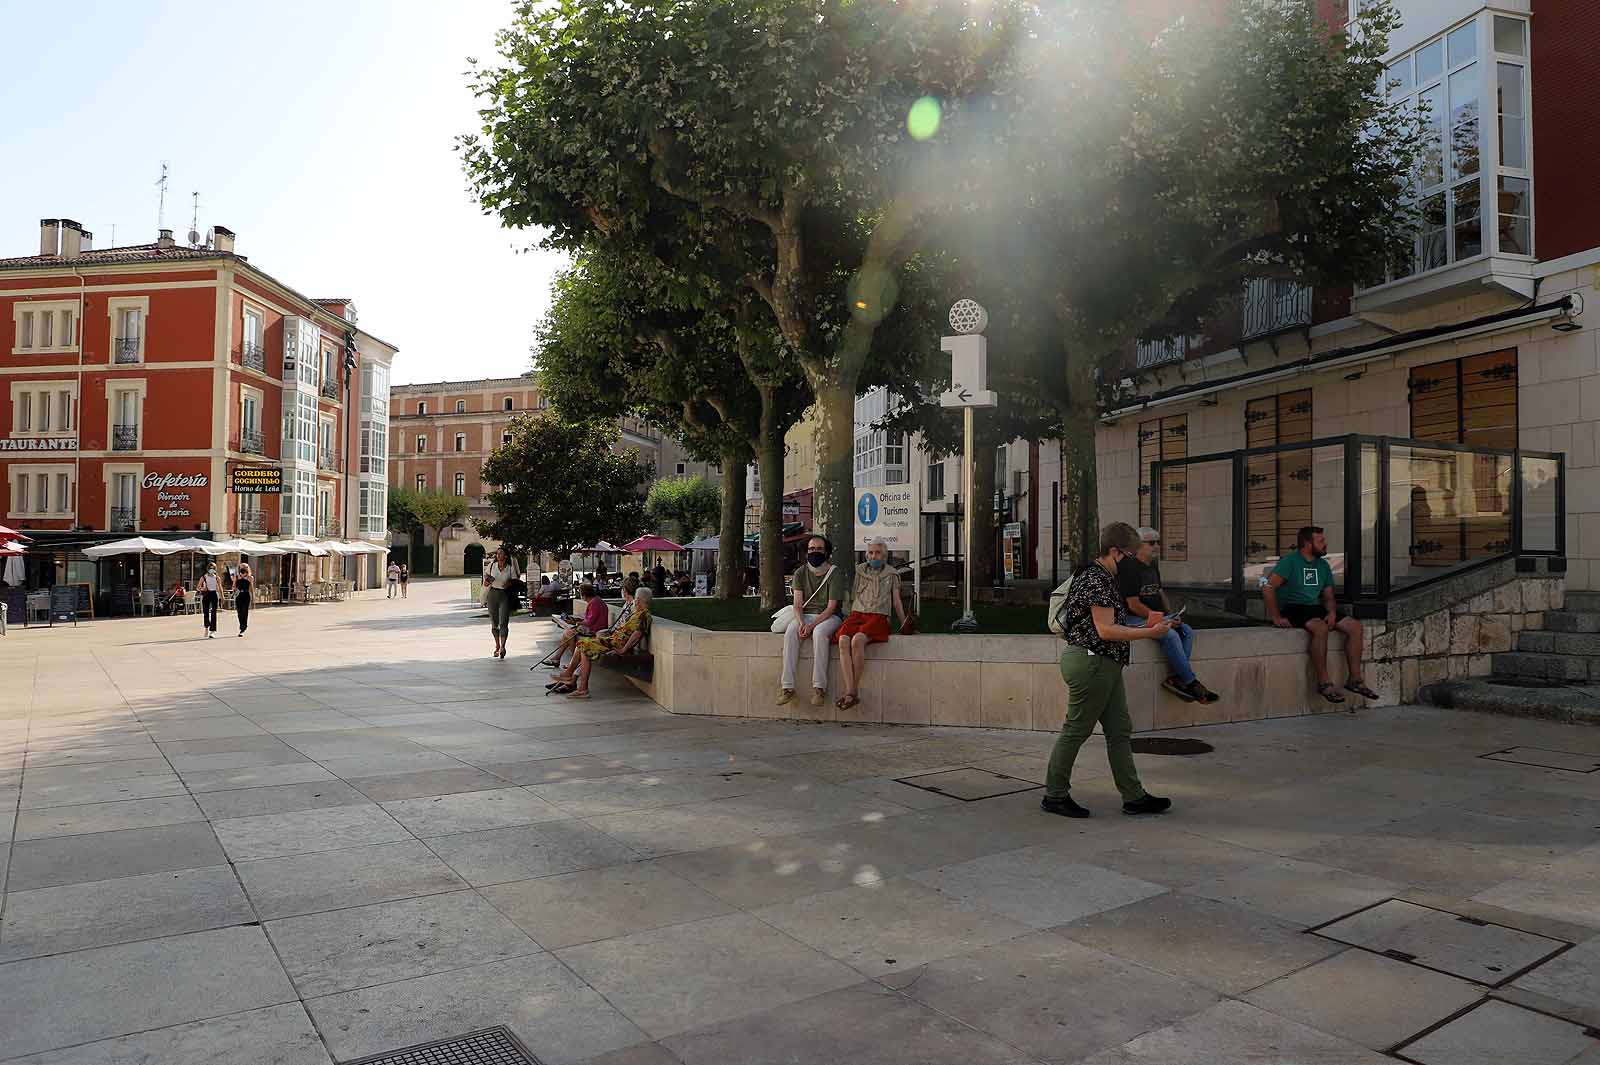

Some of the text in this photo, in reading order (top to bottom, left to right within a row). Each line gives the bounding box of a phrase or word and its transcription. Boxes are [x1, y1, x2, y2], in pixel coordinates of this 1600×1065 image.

[0, 439, 77, 449] TAURANTE
[142, 472, 208, 490] Cafetería
[157, 492, 191, 501] Rincón
[880, 492, 911, 502] Oficina de
[157, 507, 190, 519] España
[883, 507, 908, 516] Turismo
